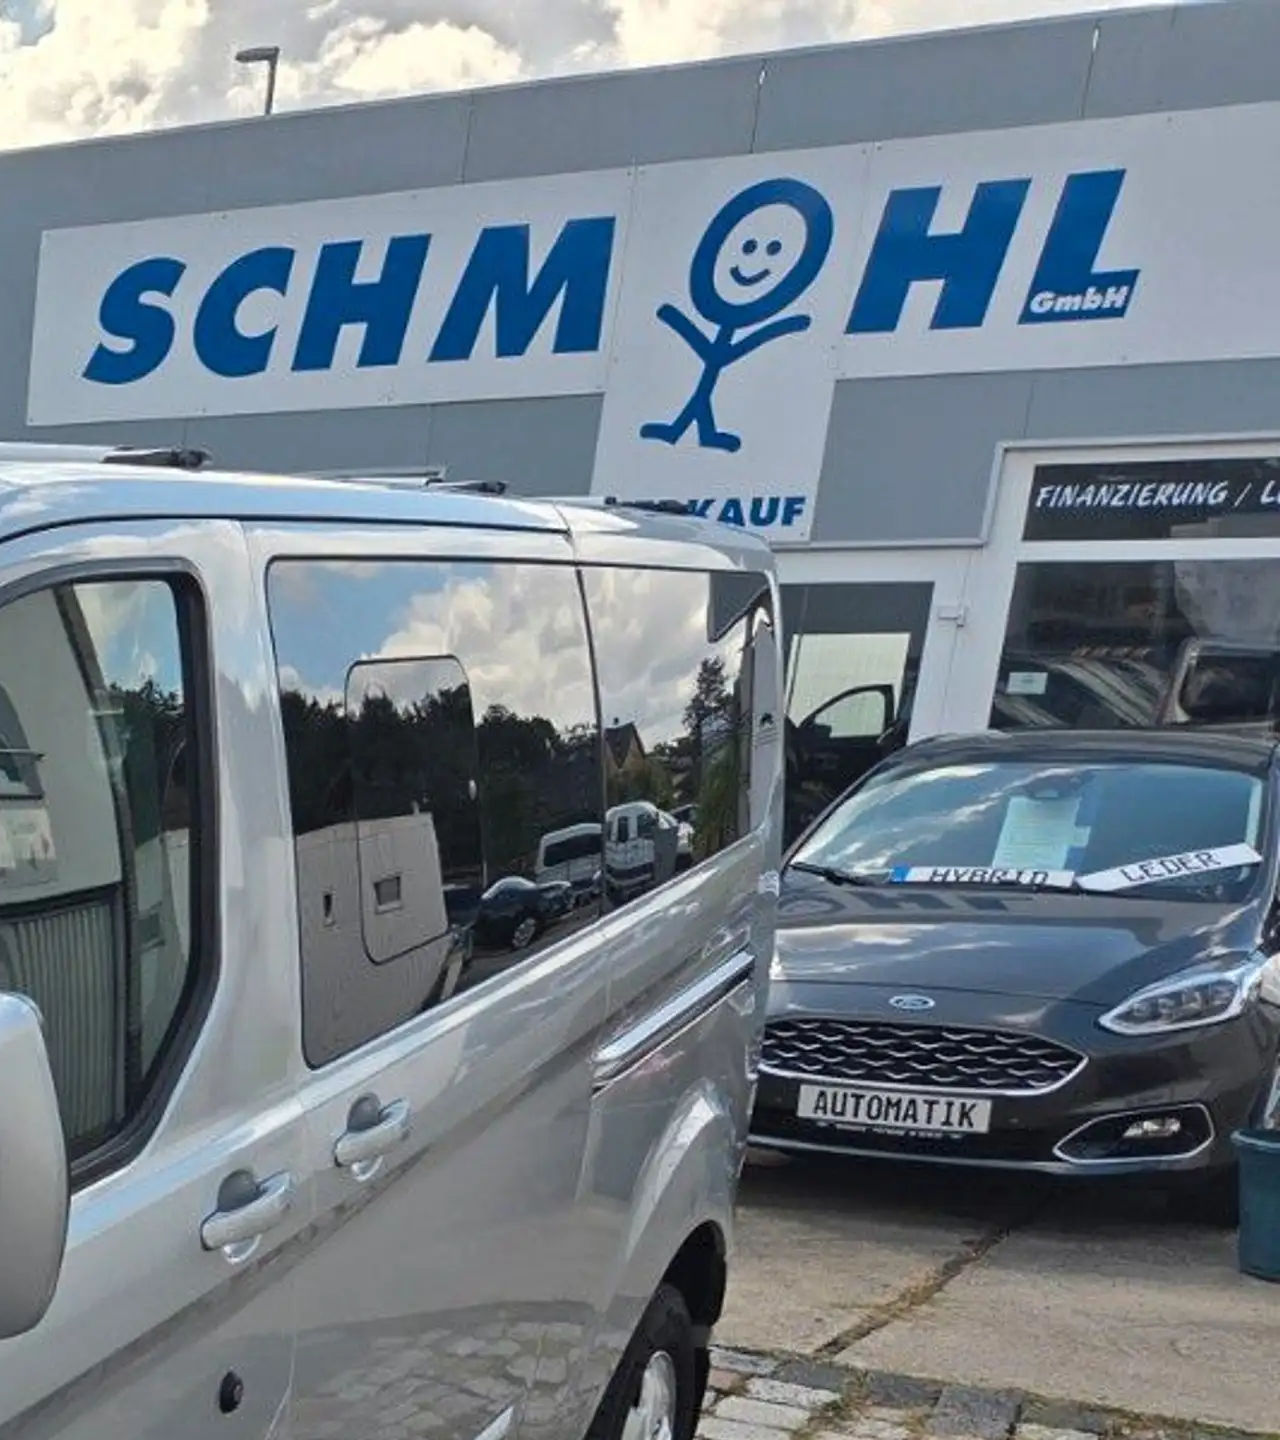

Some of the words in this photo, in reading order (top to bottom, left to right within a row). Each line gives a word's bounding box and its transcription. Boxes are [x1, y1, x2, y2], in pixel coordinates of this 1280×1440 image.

[1030, 285, 1129, 313] GmbH
[1035, 479, 1229, 508] FINANZIERUNG
[1260, 479, 1280, 505] L
[1118, 851, 1222, 883] LEDER
[813, 1089, 977, 1129] AUTOMATIK
